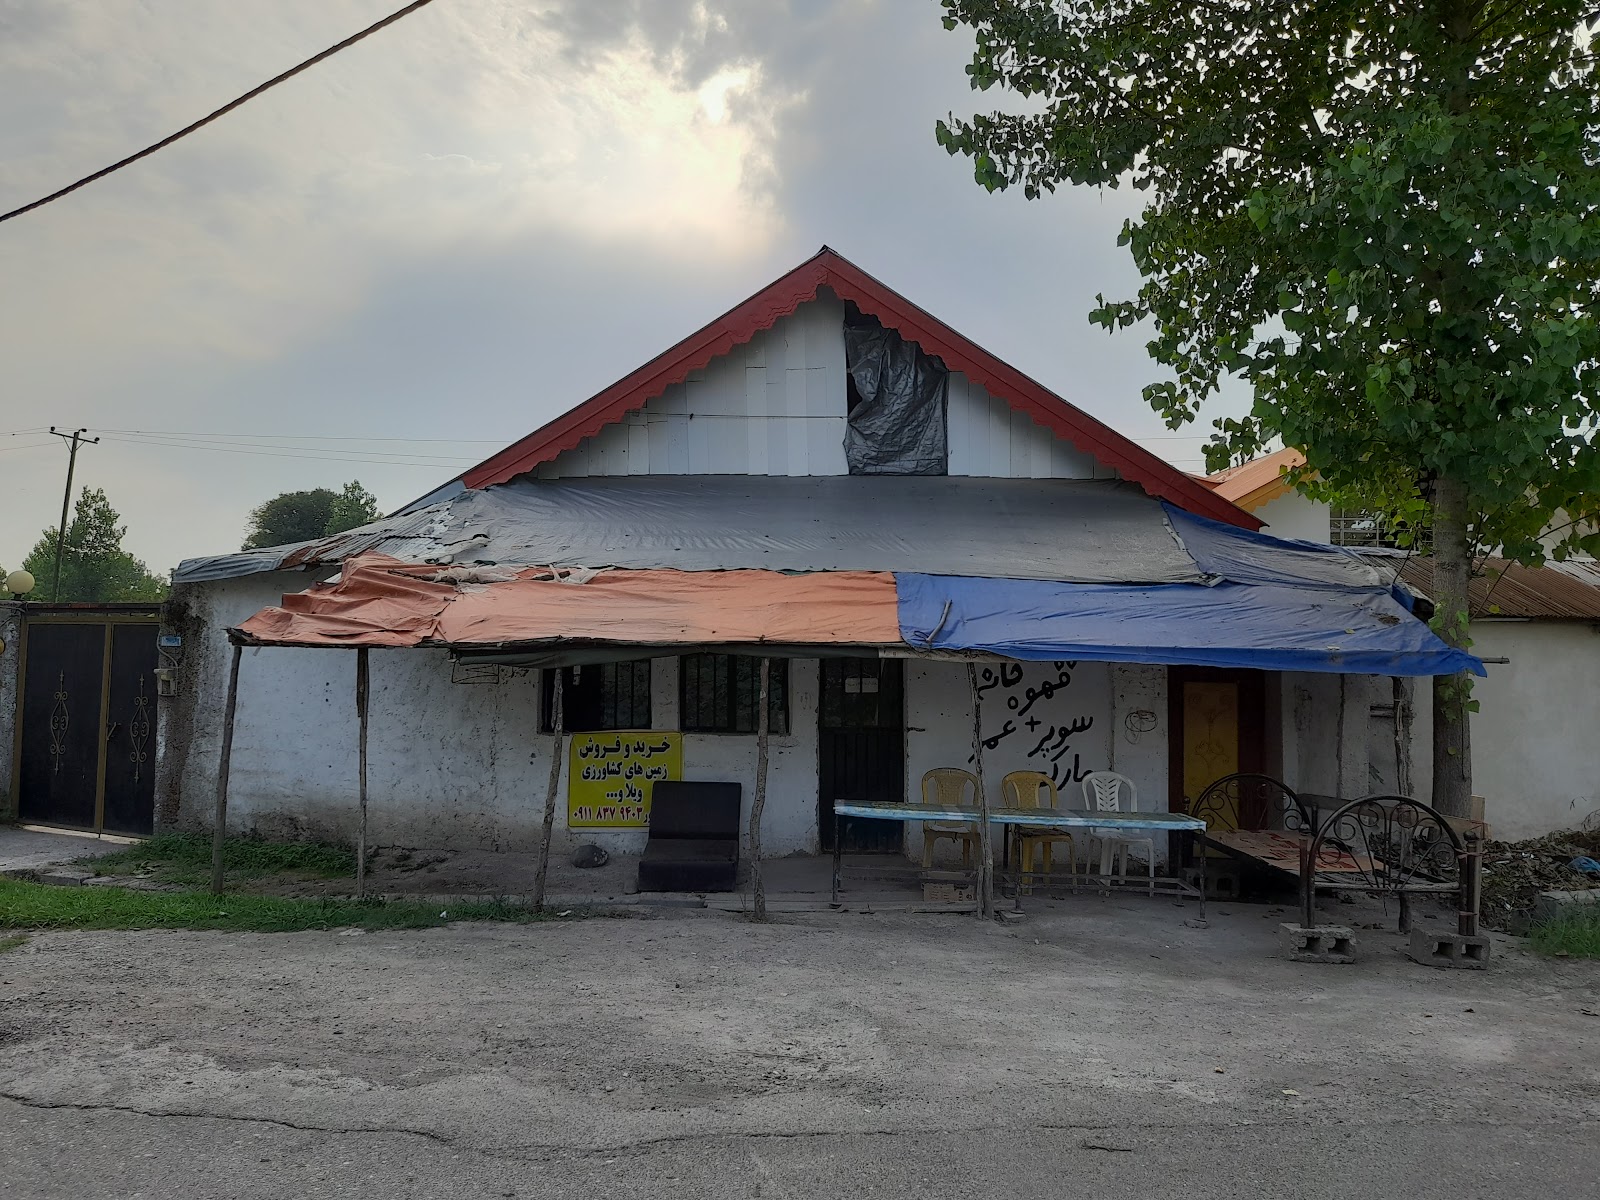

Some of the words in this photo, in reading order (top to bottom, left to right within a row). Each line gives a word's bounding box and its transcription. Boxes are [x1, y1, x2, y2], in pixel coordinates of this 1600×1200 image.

[579, 735, 621, 758] فروش
[1027, 716, 1094, 758] سوپر
[623, 743, 631, 758] و
[633, 736, 671, 758] خرید
[582, 761, 623, 780] کشاورزی
[624, 761, 643, 780] های
[645, 763, 668, 780] زمین
[625, 783, 643, 803] ویلا
[573, 806, 592, 820] ۰۹۱۱
[596, 806, 616, 820] ۸۳۷
